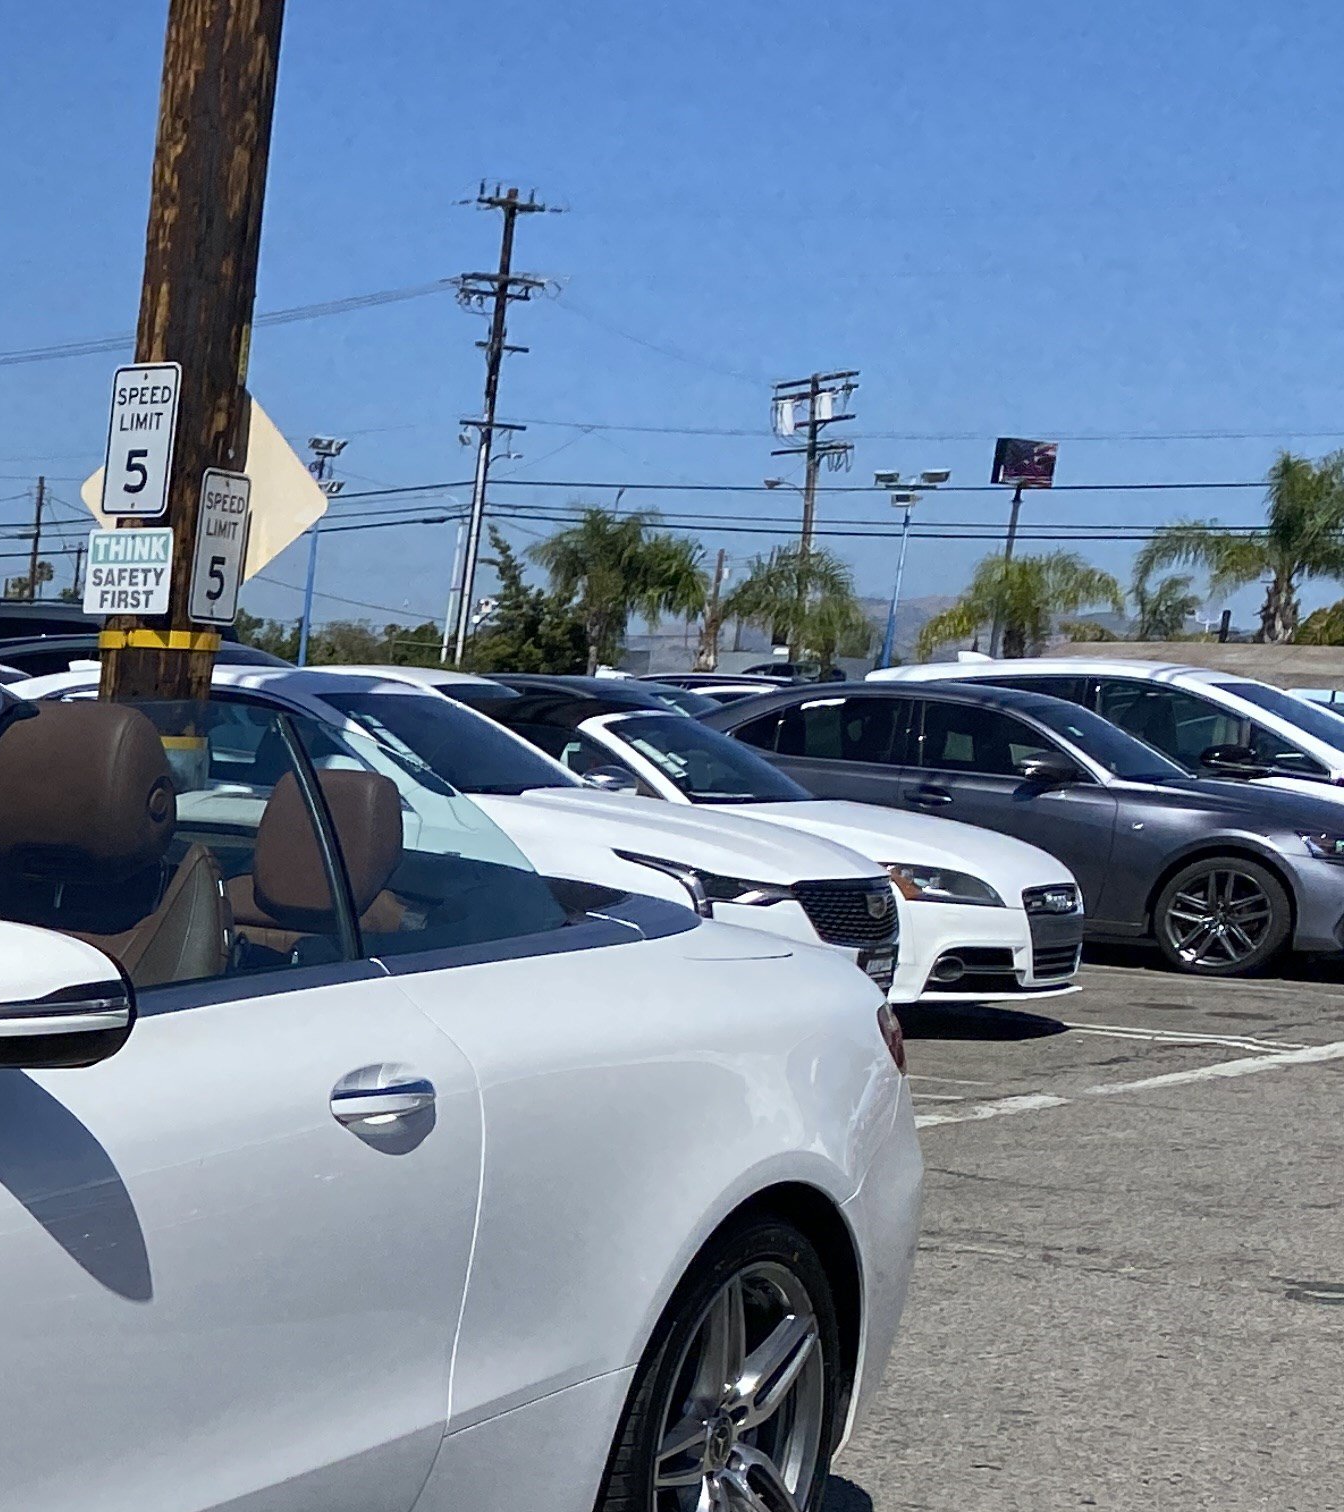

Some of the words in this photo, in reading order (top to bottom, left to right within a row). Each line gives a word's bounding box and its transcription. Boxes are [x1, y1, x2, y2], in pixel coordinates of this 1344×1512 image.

[117, 386, 172, 406] SPEED
[119, 412, 164, 432] LIMIT
[122, 449, 148, 494] 5
[205, 491, 246, 515] SPEED
[206, 517, 238, 540] LIMIT
[95, 534, 168, 562] THINK
[92, 567, 165, 588] SAFETY
[206, 556, 226, 601] 5
[99, 590, 154, 609] FIRST
